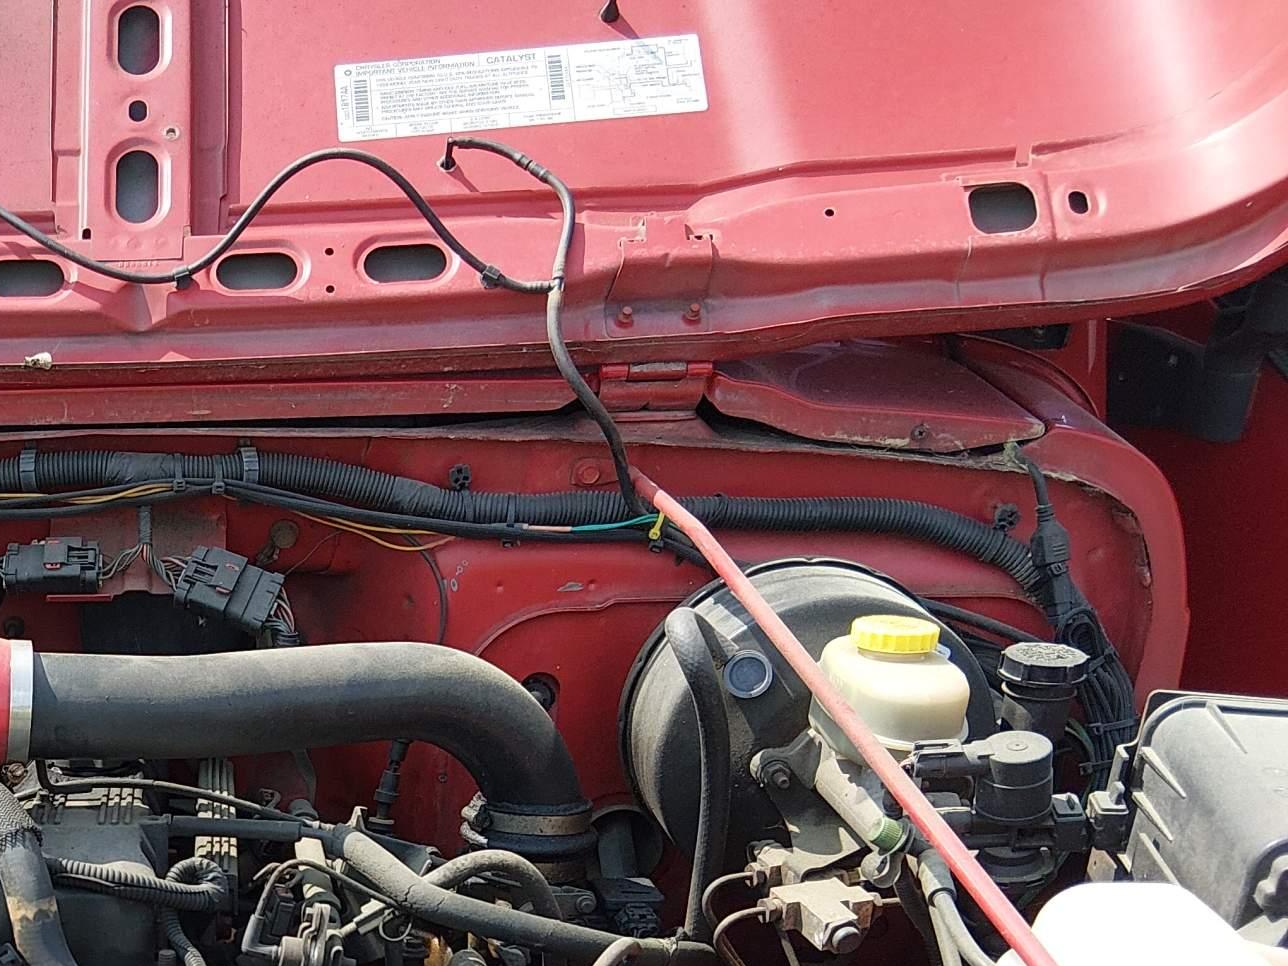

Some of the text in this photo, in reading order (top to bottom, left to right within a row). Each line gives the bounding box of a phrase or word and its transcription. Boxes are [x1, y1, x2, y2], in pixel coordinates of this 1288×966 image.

[393, 59, 441, 68] CORPORATION
[486, 53, 536, 65] CATALYST
[427, 61, 475, 71] INFORMATION
